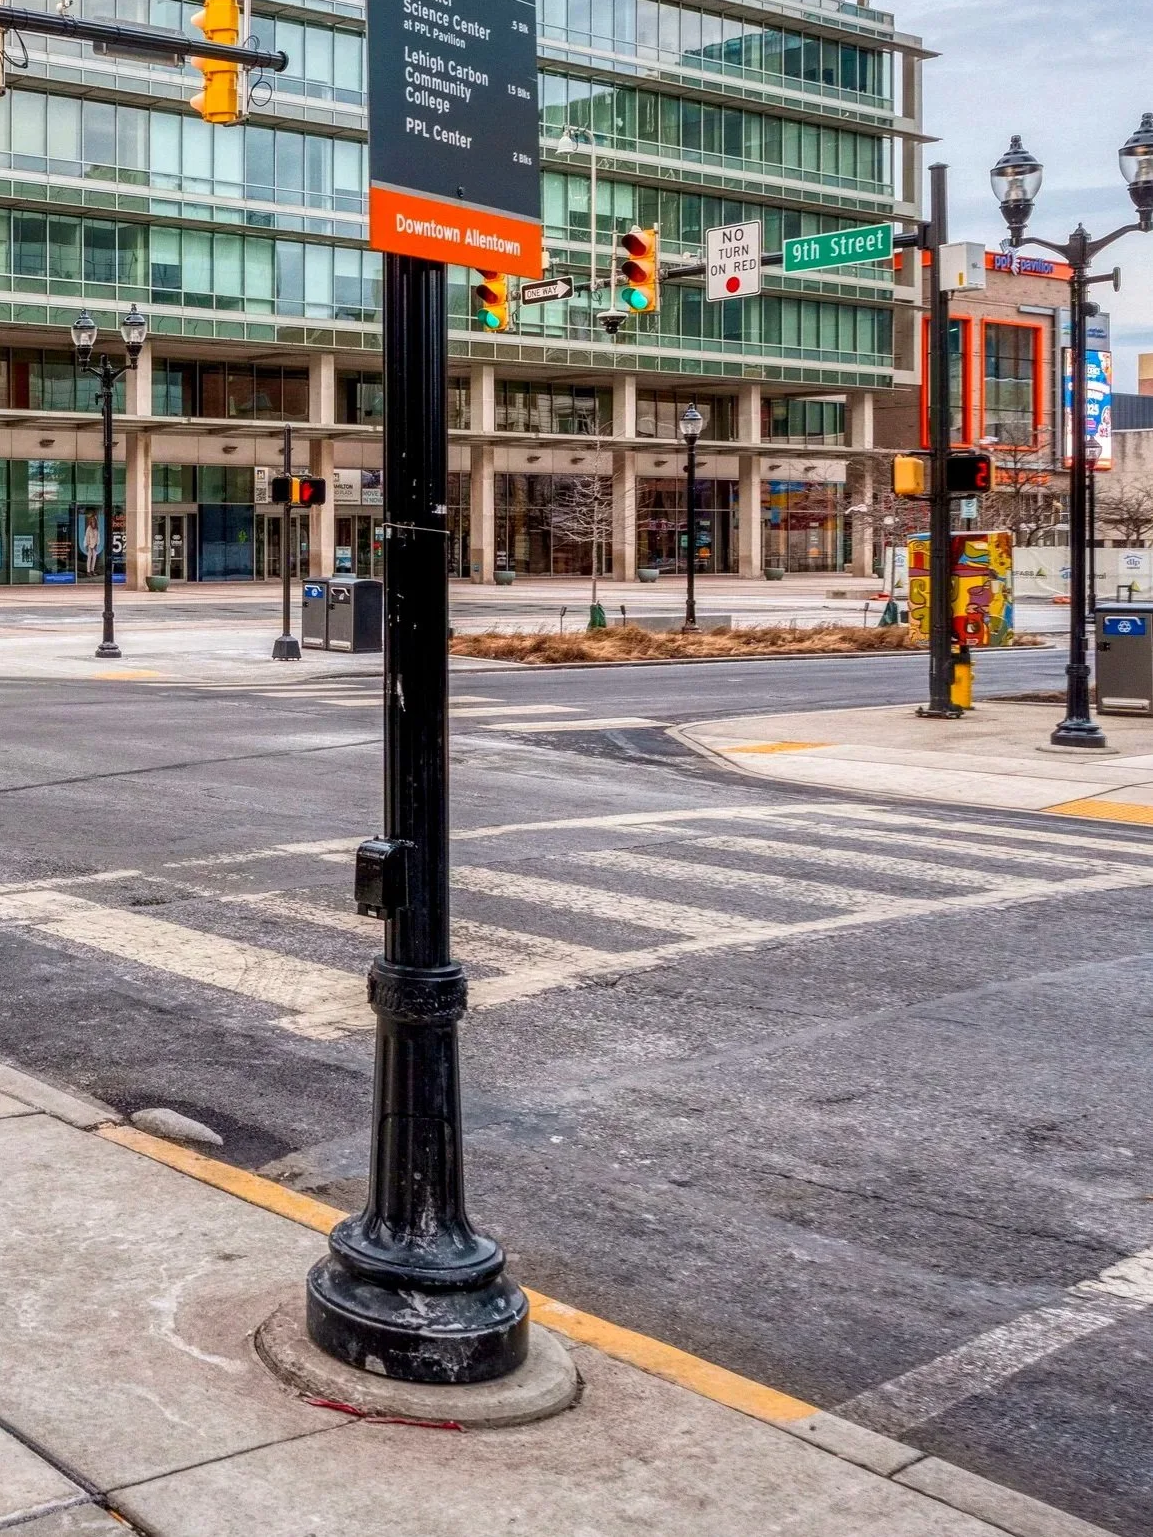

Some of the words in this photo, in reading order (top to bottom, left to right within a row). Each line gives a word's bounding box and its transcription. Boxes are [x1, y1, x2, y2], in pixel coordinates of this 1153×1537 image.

[403, 19, 413, 30] at
[415, 22, 431, 38] PPL
[433, 28, 465, 48] Pavilion
[453, 16, 491, 40] Center
[519, 22, 529, 34] Blk
[405, 46, 444, 73] Lehigh
[448, 60, 489, 86] Carbon
[405, 66, 471, 103] Community
[517, 88, 530, 100] Blks
[406, 86, 450, 114] College
[406, 117, 429, 138] PPL
[433, 125, 472, 149] Center
[513, 152, 517, 162] 2
[519, 154, 532, 166] Blks
[396, 214, 460, 243] Downtown
[465, 228, 521, 256] Allentown
[722, 228, 744, 244] NO
[719, 244, 749, 259] TURN
[793, 240, 819, 262] 9th
[831, 230, 883, 256] Street
[710, 263, 726, 276] ON
[734, 259, 756, 272] RED
[1020, 258, 1053, 273] pavilion
[527, 288, 541, 298] ONE
[542, 286, 557, 296] WAY
